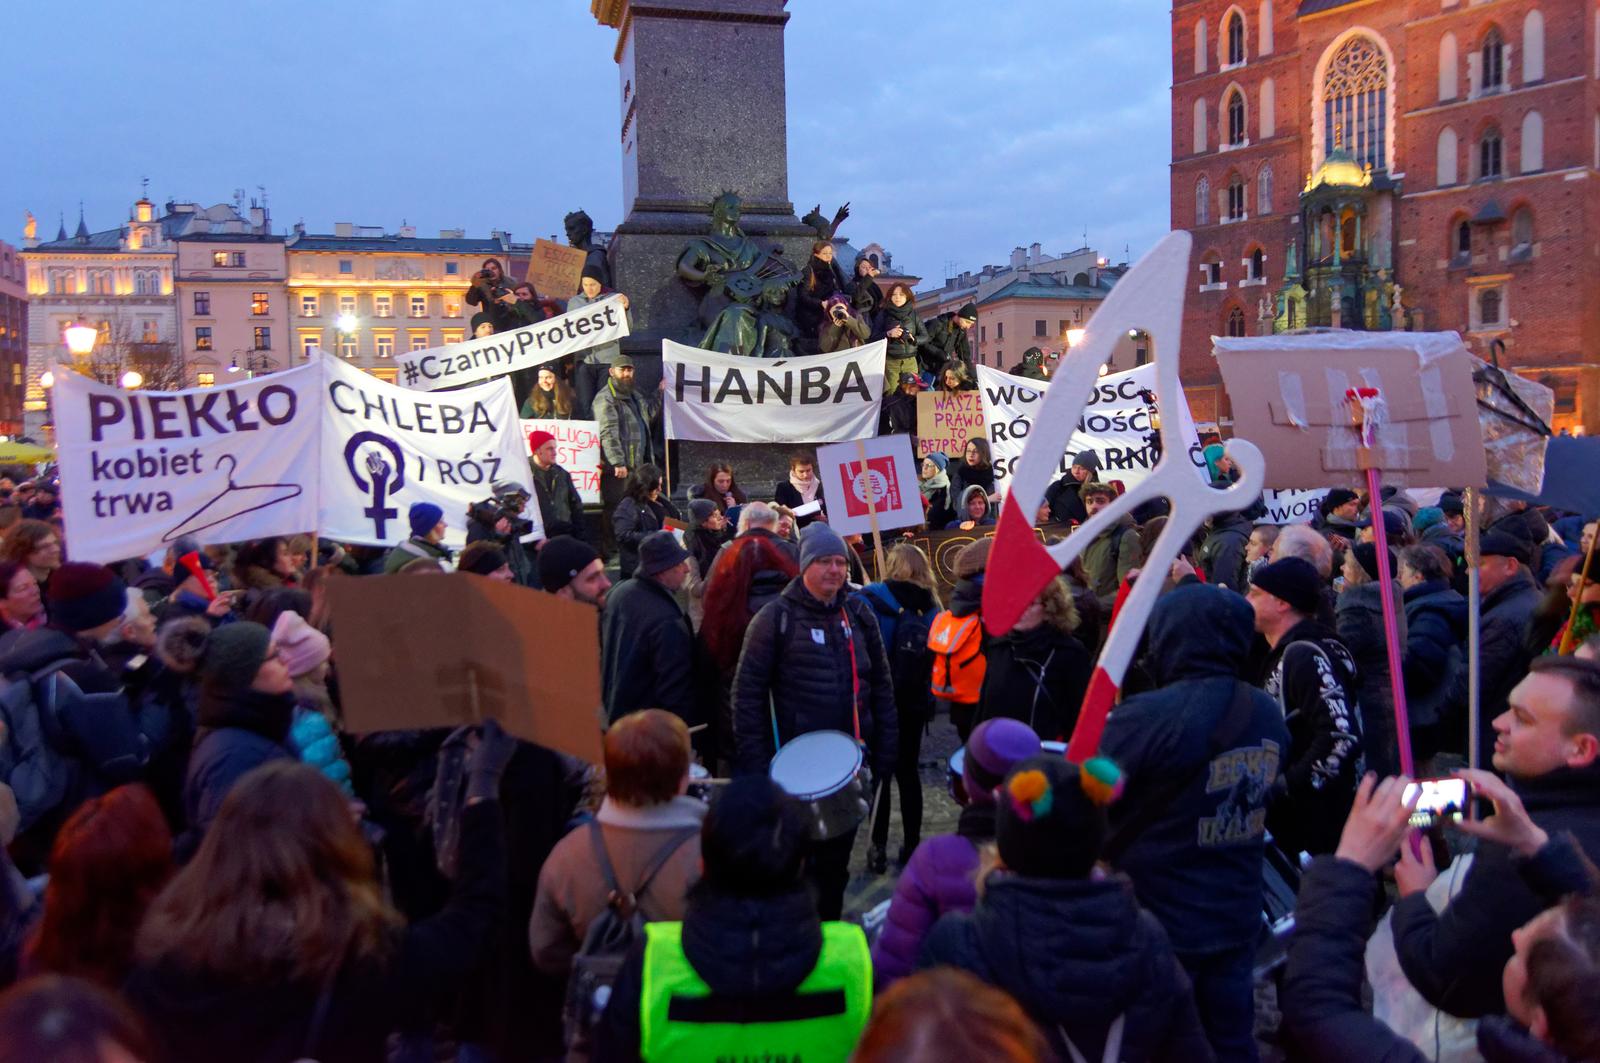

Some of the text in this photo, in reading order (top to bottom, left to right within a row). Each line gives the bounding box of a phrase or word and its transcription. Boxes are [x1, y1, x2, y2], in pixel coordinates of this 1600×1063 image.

[404, 305, 617, 386] #CzarnyProtest
[675, 360, 873, 406] HAŃBA
[88, 384, 298, 442] PIEKŁO
[329, 380, 497, 434] CHLEBA
[934, 394, 983, 412] WASZE
[934, 412, 985, 428] PRAWO
[949, 428, 967, 440] TO
[91, 446, 204, 482] kobiet
[418, 451, 502, 485] I RÓŻ
[91, 489, 174, 518] trwa
[1270, 495, 1328, 523] WOB
